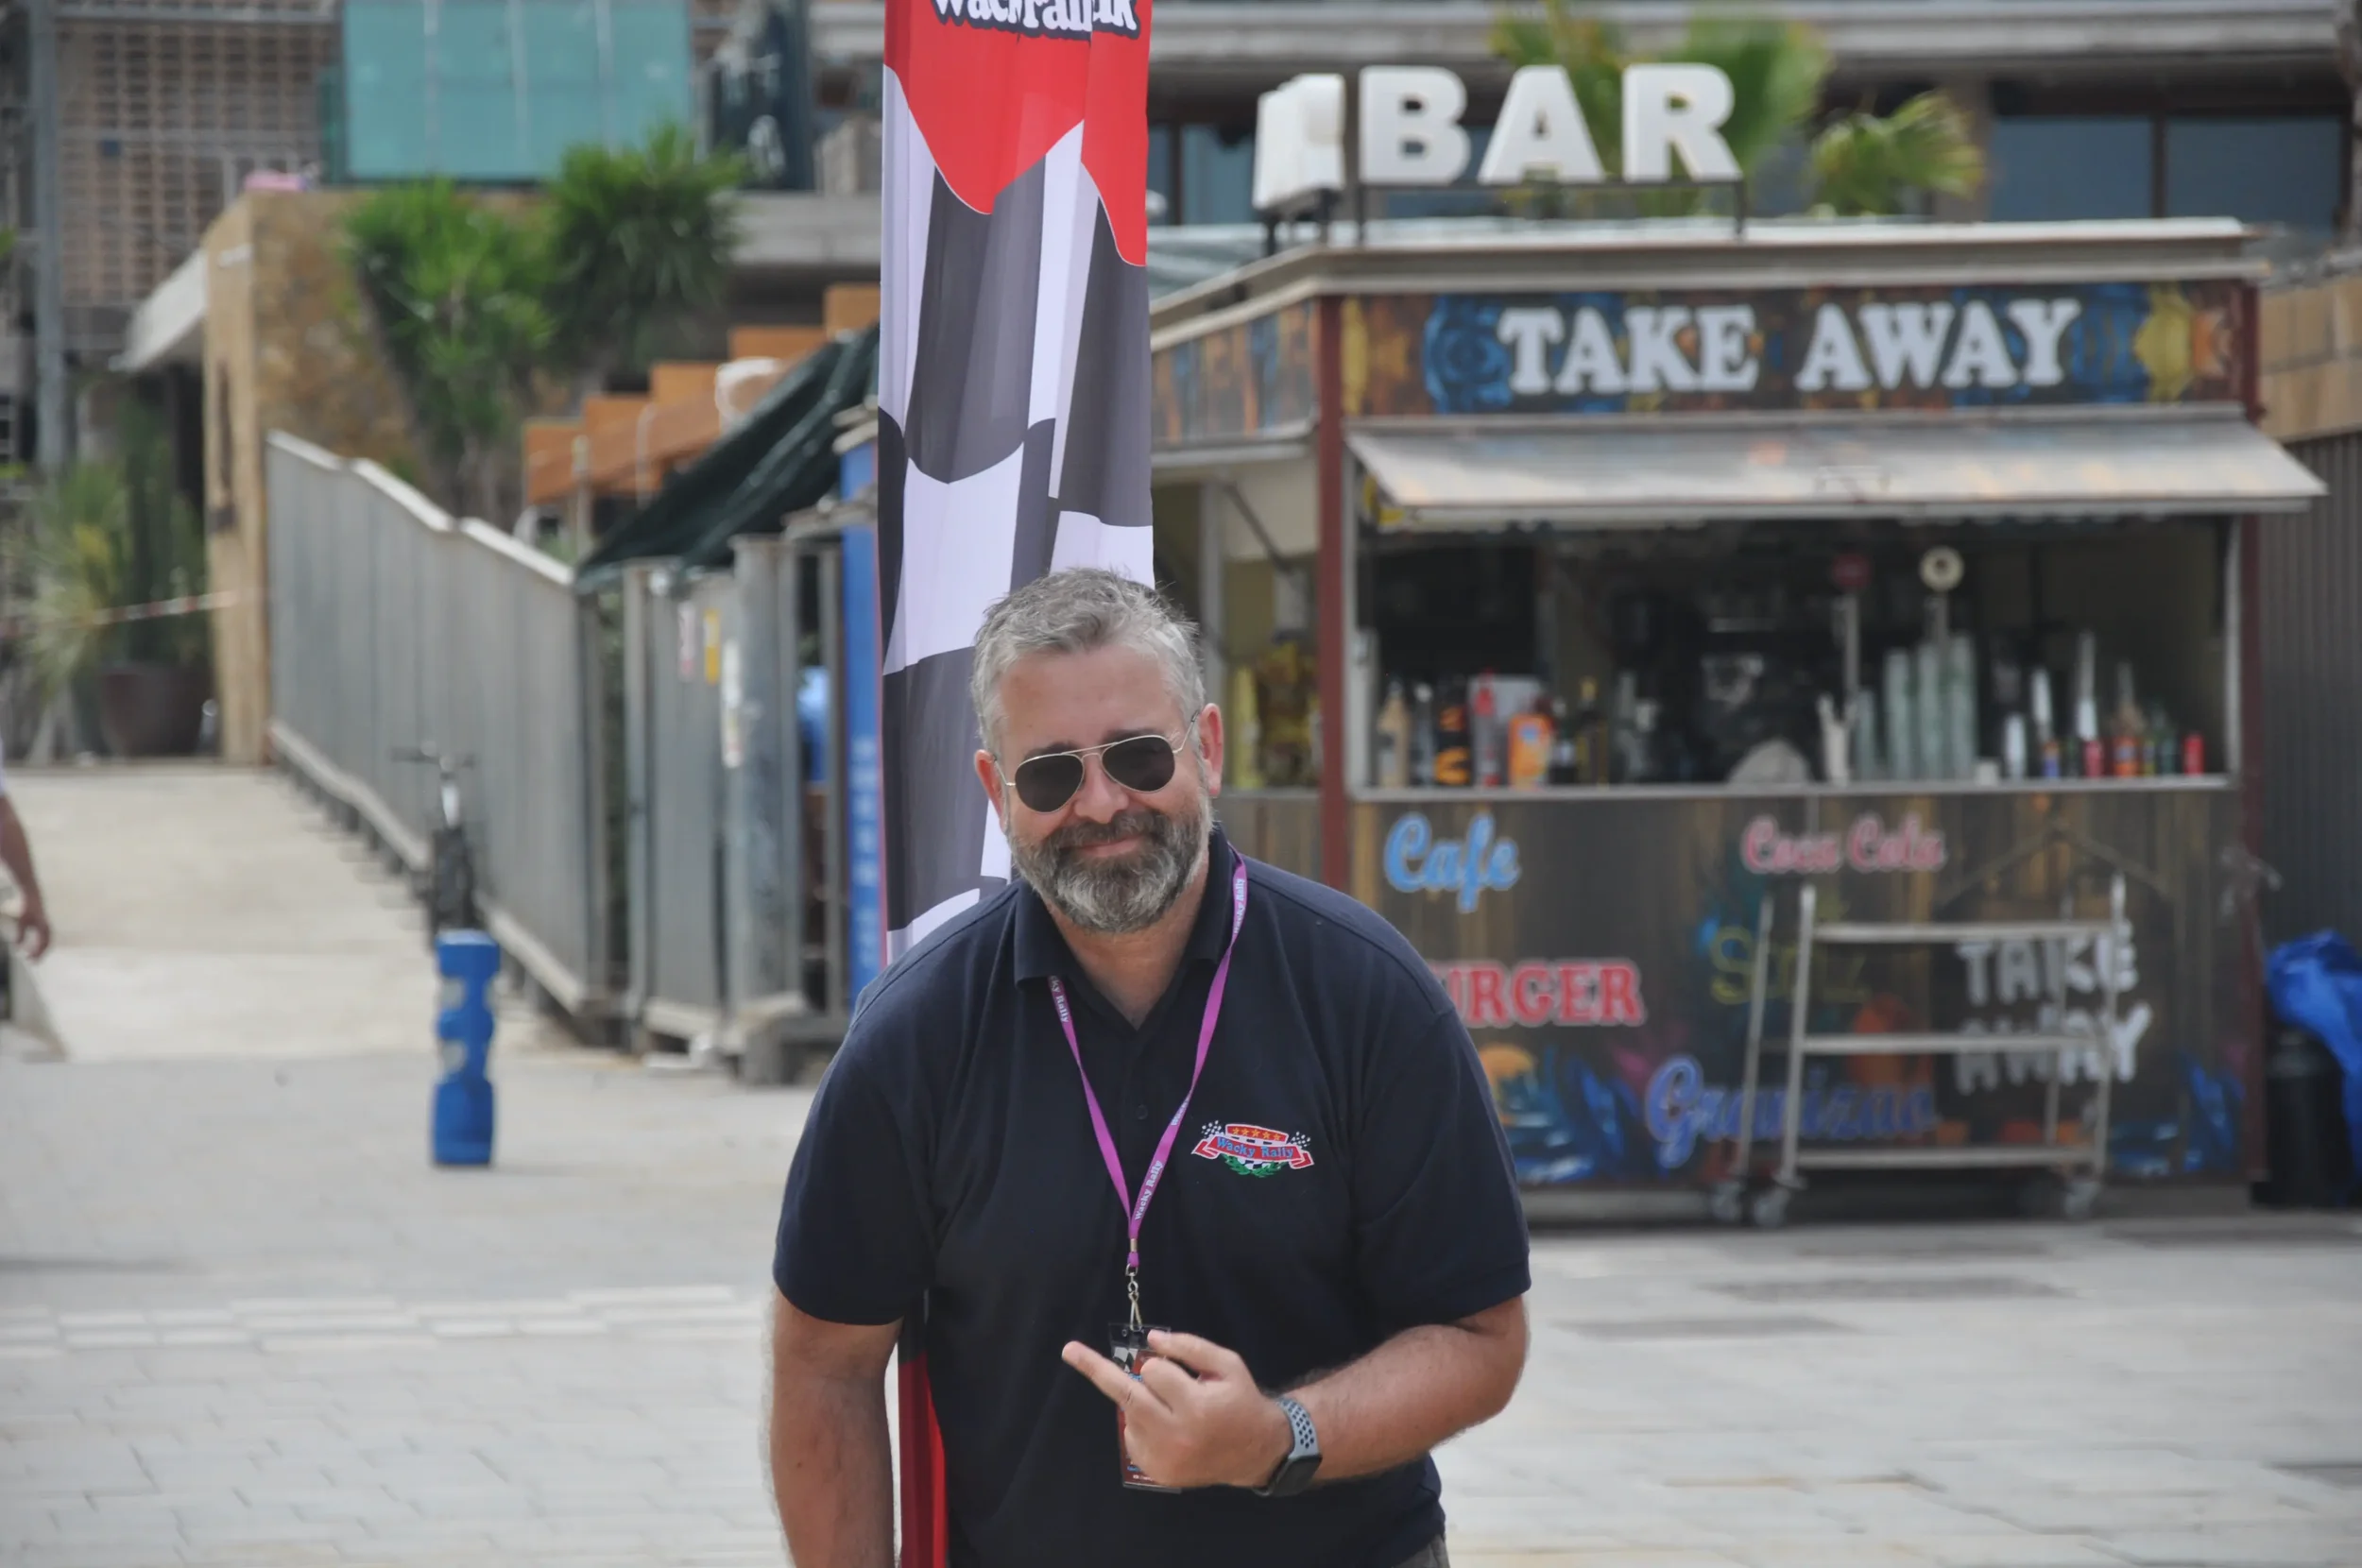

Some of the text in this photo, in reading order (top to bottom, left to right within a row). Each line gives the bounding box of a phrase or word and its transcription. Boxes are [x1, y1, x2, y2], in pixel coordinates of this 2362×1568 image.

[1361, 64, 1743, 184] BAR
[1498, 298, 2081, 395] TAKE AWAY
[1384, 812, 1521, 913] Cafe
[1056, 995, 1070, 1023] Rally
[1216, 1136, 1293, 1158] Wacky Rally
[1135, 1160, 1163, 1220] Wacky Rally
